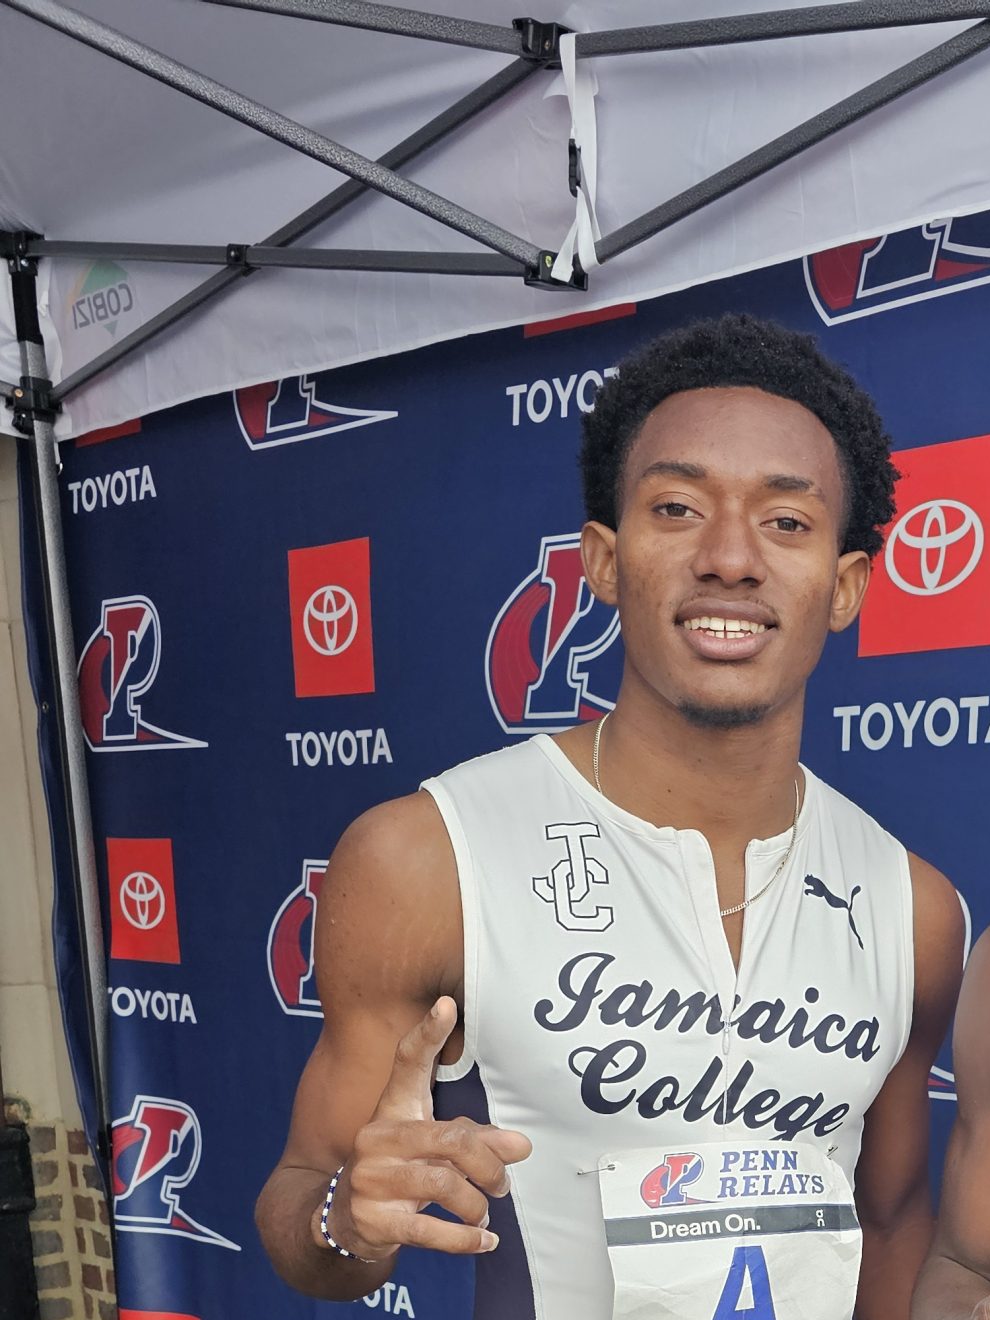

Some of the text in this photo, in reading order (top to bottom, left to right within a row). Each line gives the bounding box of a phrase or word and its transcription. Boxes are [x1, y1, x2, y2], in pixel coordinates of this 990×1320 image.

[506, 366, 620, 426] TOYO
[68, 465, 157, 514] TOYOTA
[285, 727, 394, 767] TOYOTA
[108, 986, 197, 1024] OYOTA
[533, 952, 881, 1063] Jamaica
[568, 1039, 850, 1141] College
[719, 1149, 798, 1173] PENN
[717, 1173, 825, 1198] RELAYS
[650, 1213, 761, 1239] Dream On.
